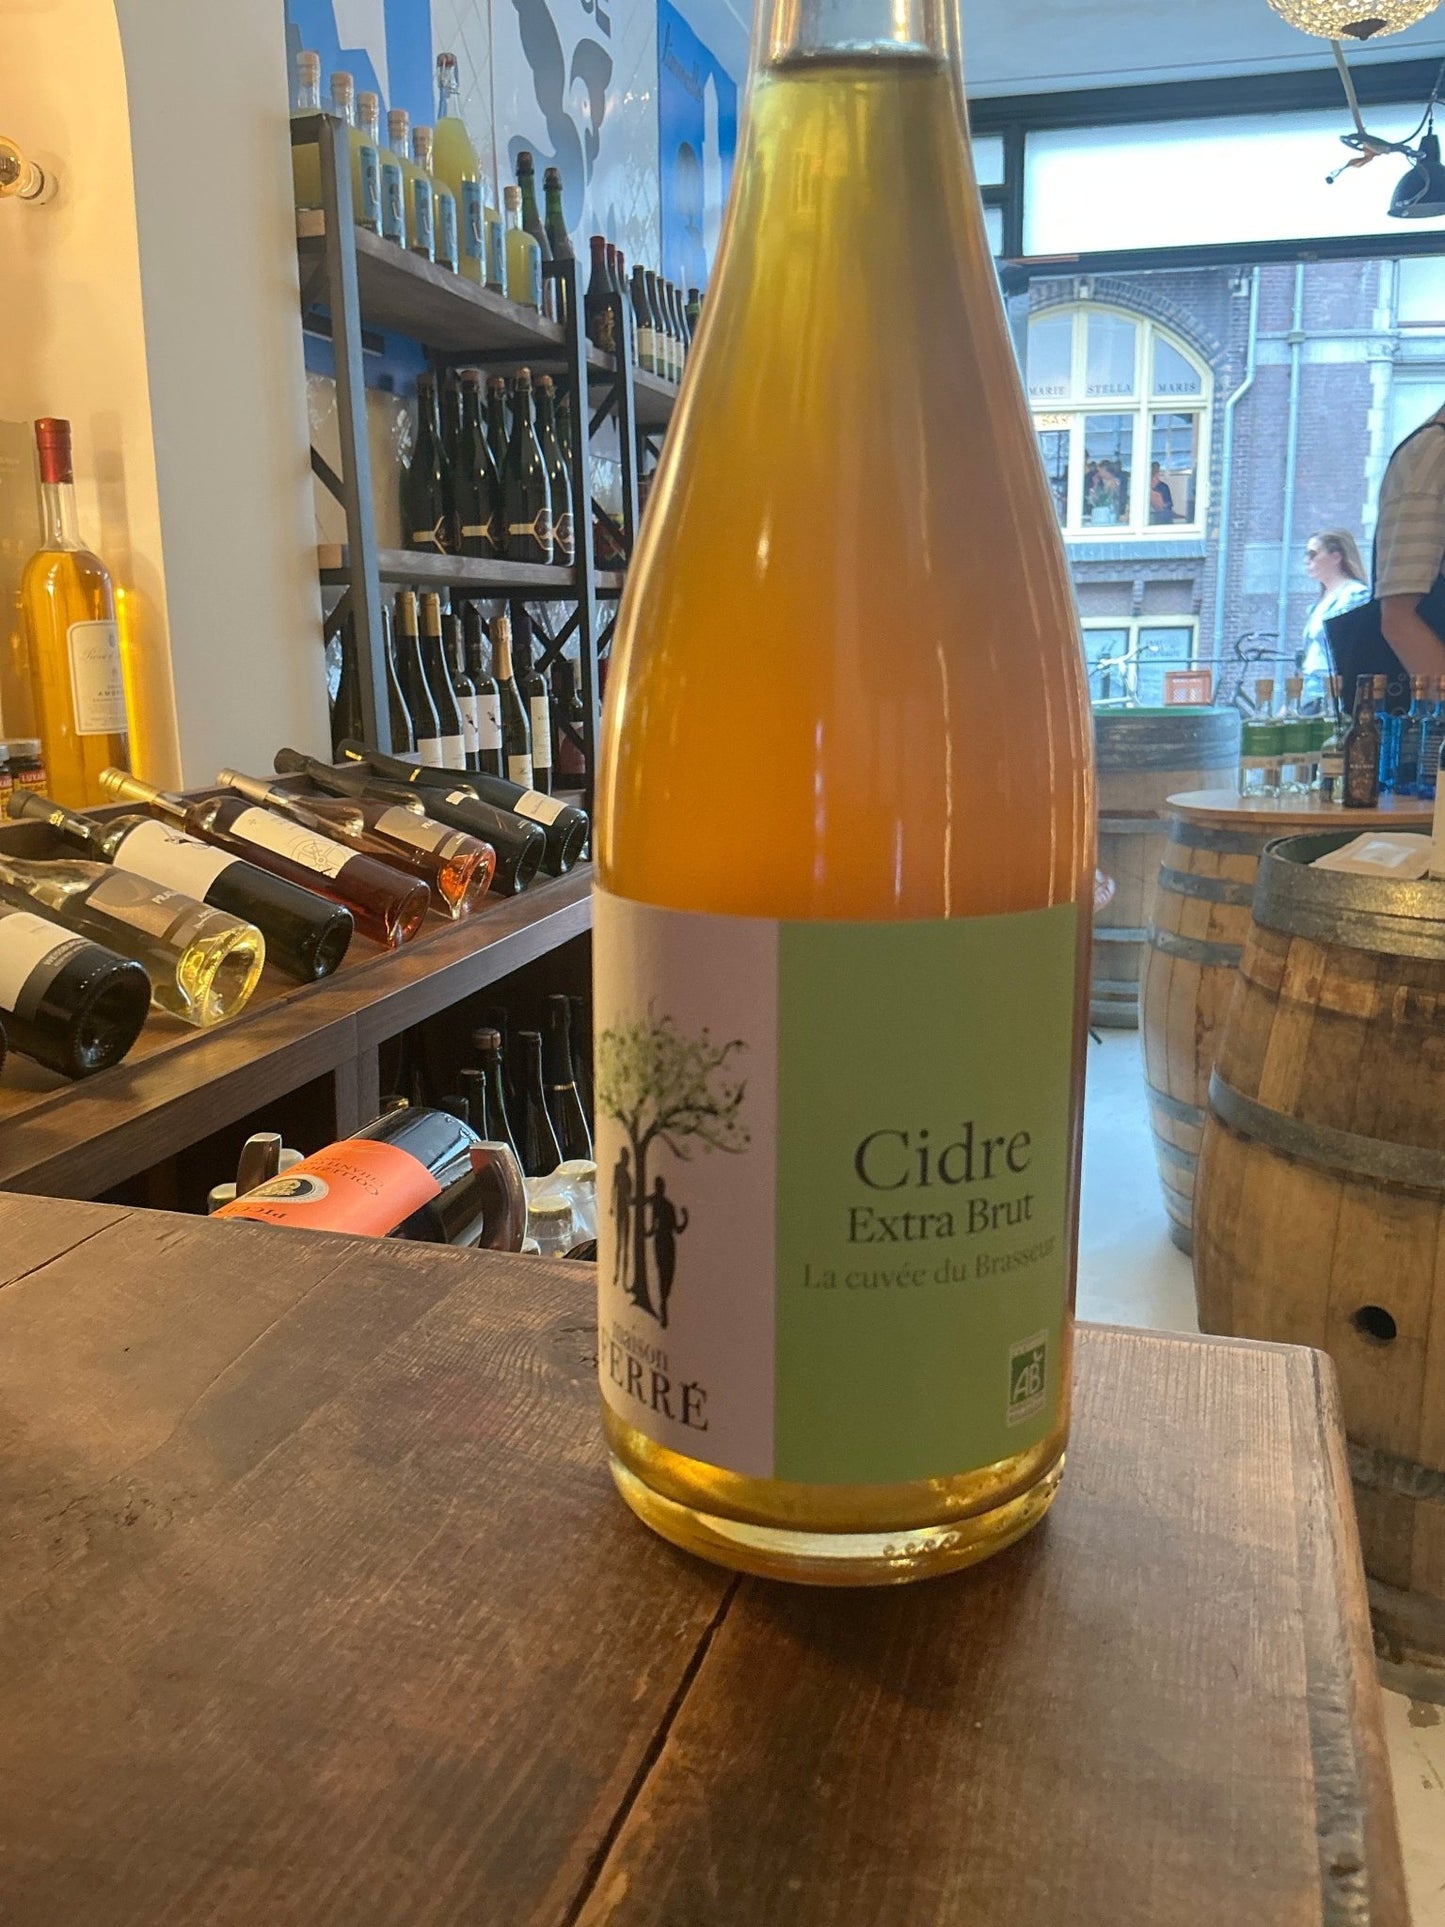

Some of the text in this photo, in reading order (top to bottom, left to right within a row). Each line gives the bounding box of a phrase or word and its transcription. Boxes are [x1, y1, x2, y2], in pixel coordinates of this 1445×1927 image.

[1086, 383, 1132, 394] STELLA
[1157, 382, 1196, 393] MARIS
[854, 1120, 1031, 1191] Cidre
[847, 1193, 1034, 1243] Extra Brut
[803, 1235, 1057, 1290] La cuvée du Brasseur
[1013, 1362, 1041, 1403] AB
